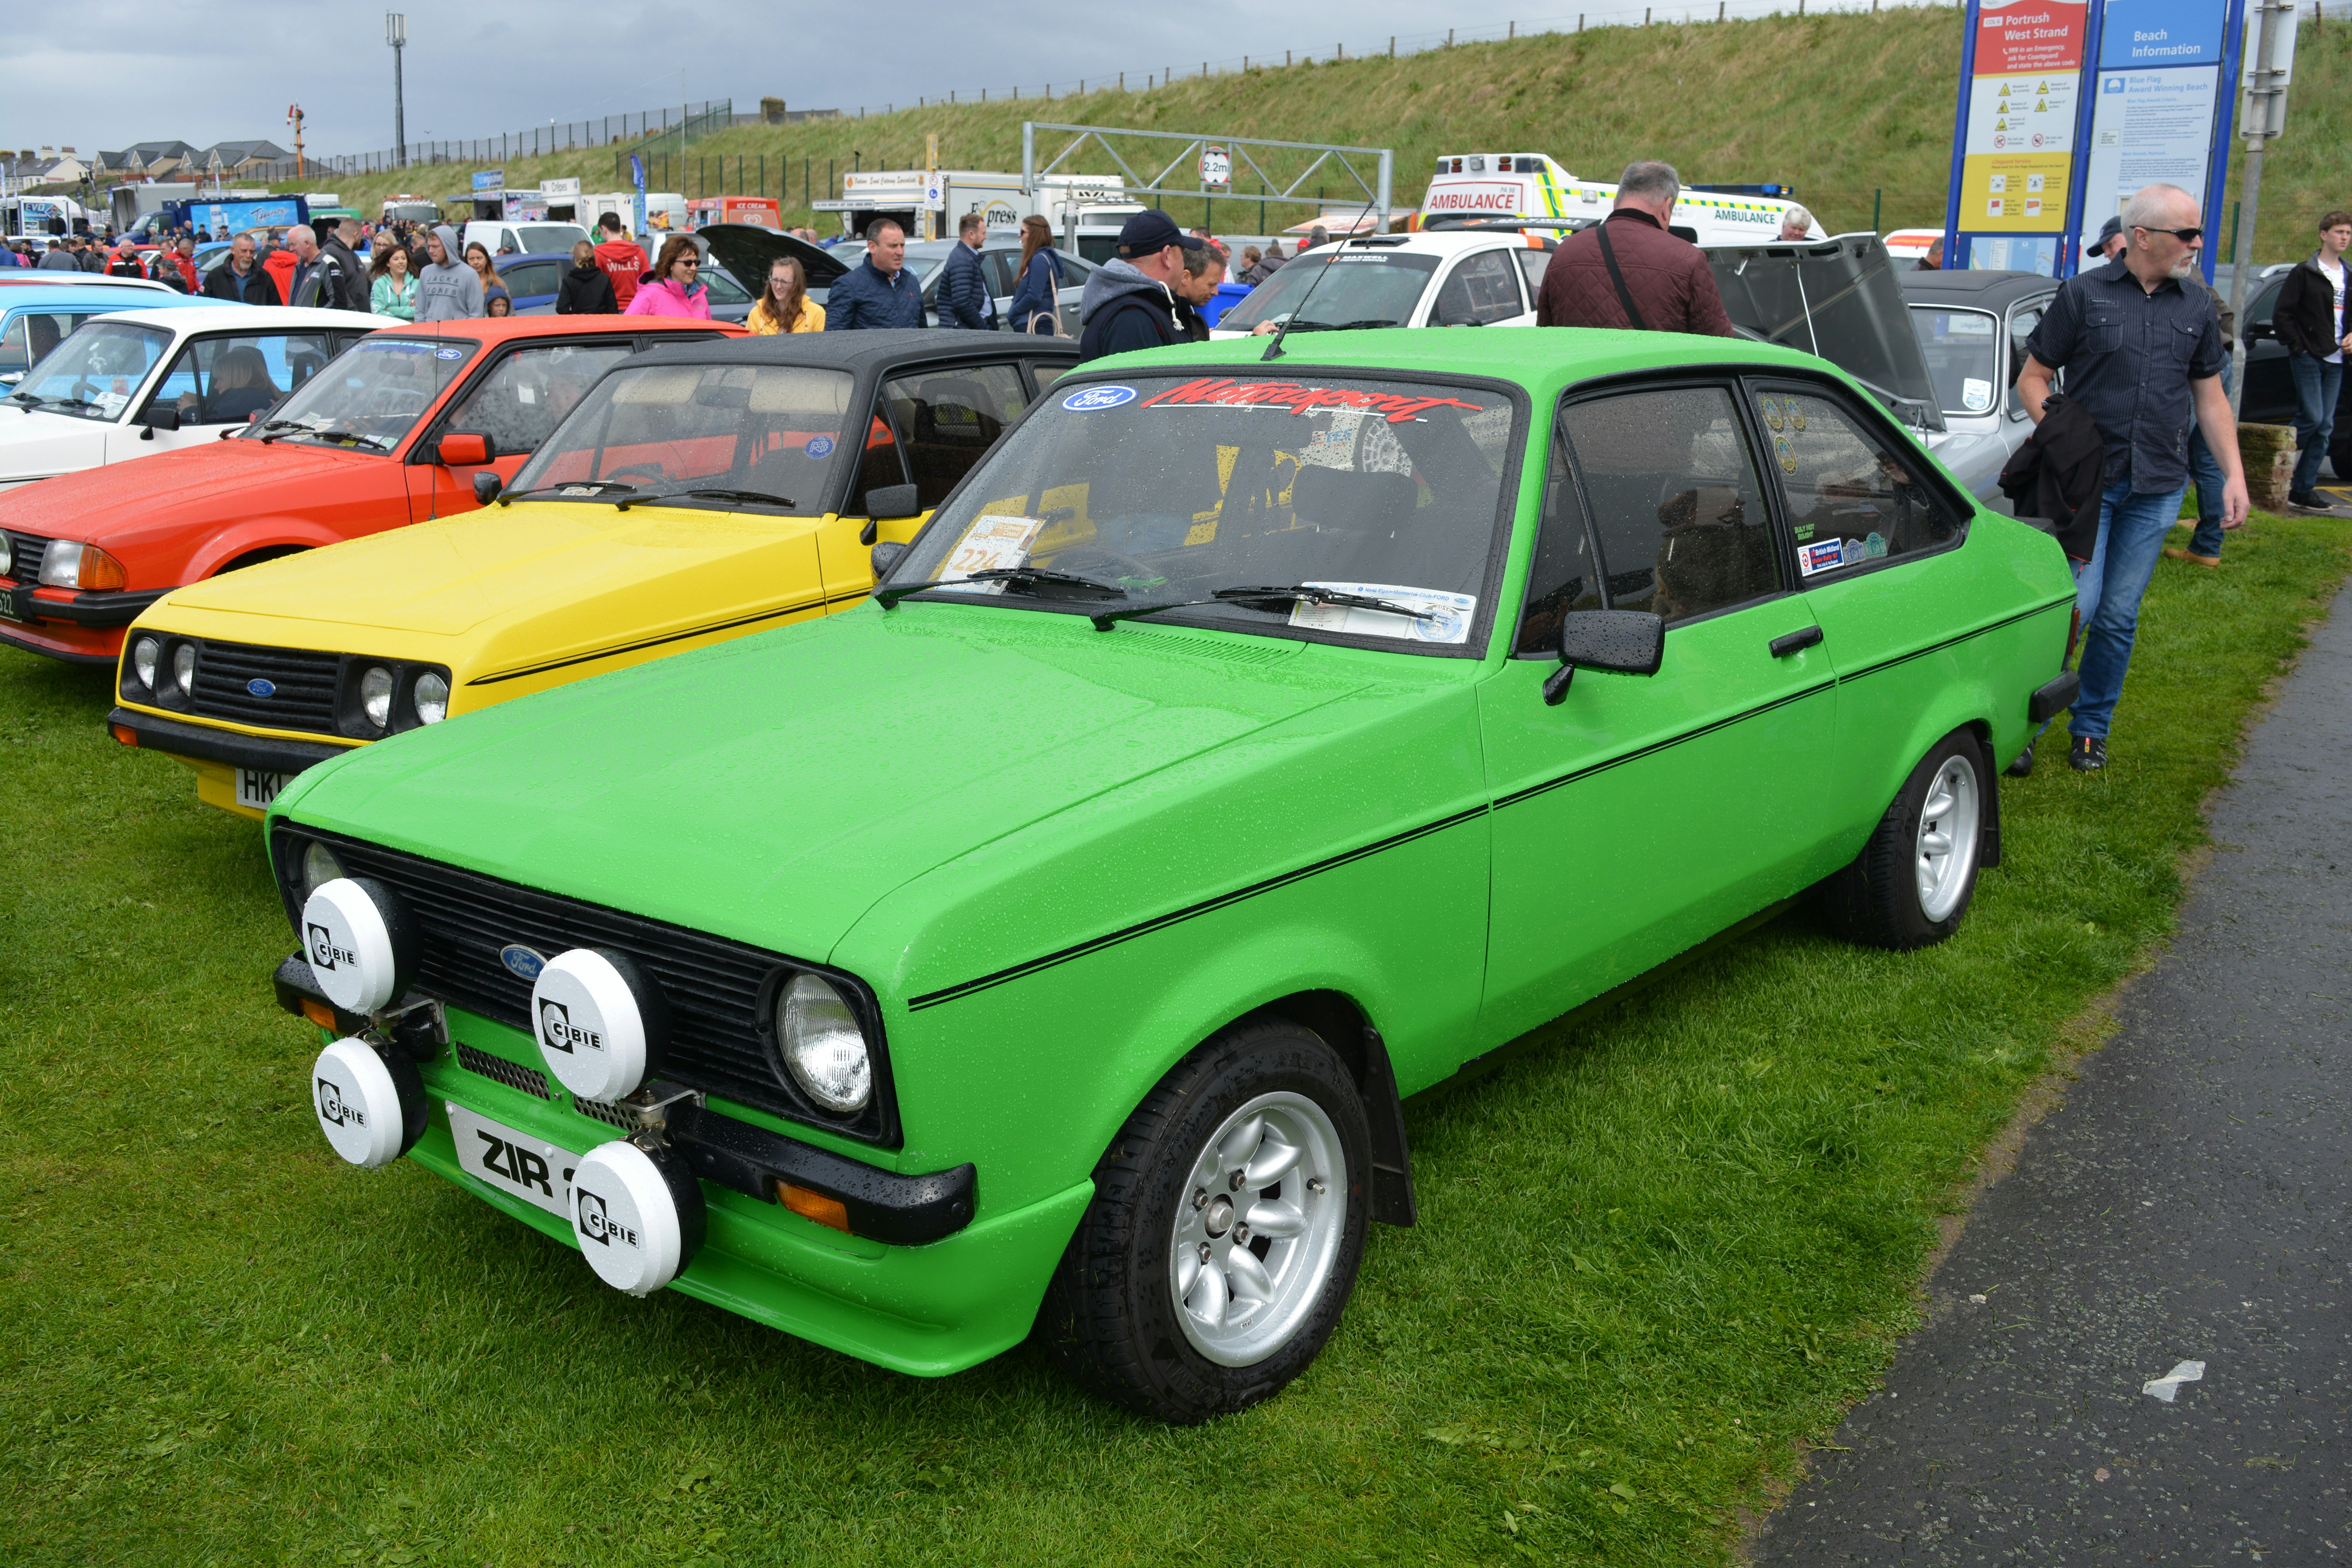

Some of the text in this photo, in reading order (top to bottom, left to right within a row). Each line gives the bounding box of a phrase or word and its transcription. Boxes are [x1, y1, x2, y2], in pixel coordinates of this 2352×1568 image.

[2006, 12, 2050, 25] Portrush
[2005, 25, 2069, 40] West Strand
[2134, 29, 2167, 42] Beach
[2034, 45, 2065, 53] Emergency,
[2132, 44, 2201, 57] Information
[2027, 53, 2058, 61] Coastguard
[2154, 84, 2183, 93] Winning
[1205, 162, 1227, 172] 2.2m
[25, 203, 45, 211] EVO
[1429, 194, 1514, 209] AMBULANCE
[1715, 210, 1775, 224] AMBULANCE
[606, 261, 640, 272] WILLS
[437, 350, 457, 358] Ford
[1074, 389, 1123, 407] Ford
[1140, 379, 1483, 423] Motorsport
[809, 441, 829, 453] RS
[1816, 544, 1839, 556] British Midland
[953, 548, 1002, 572] 224
[252, 681, 268, 693] Ford
[510, 952, 536, 975] Ford
[477, 1129, 554, 1198] ZIR
